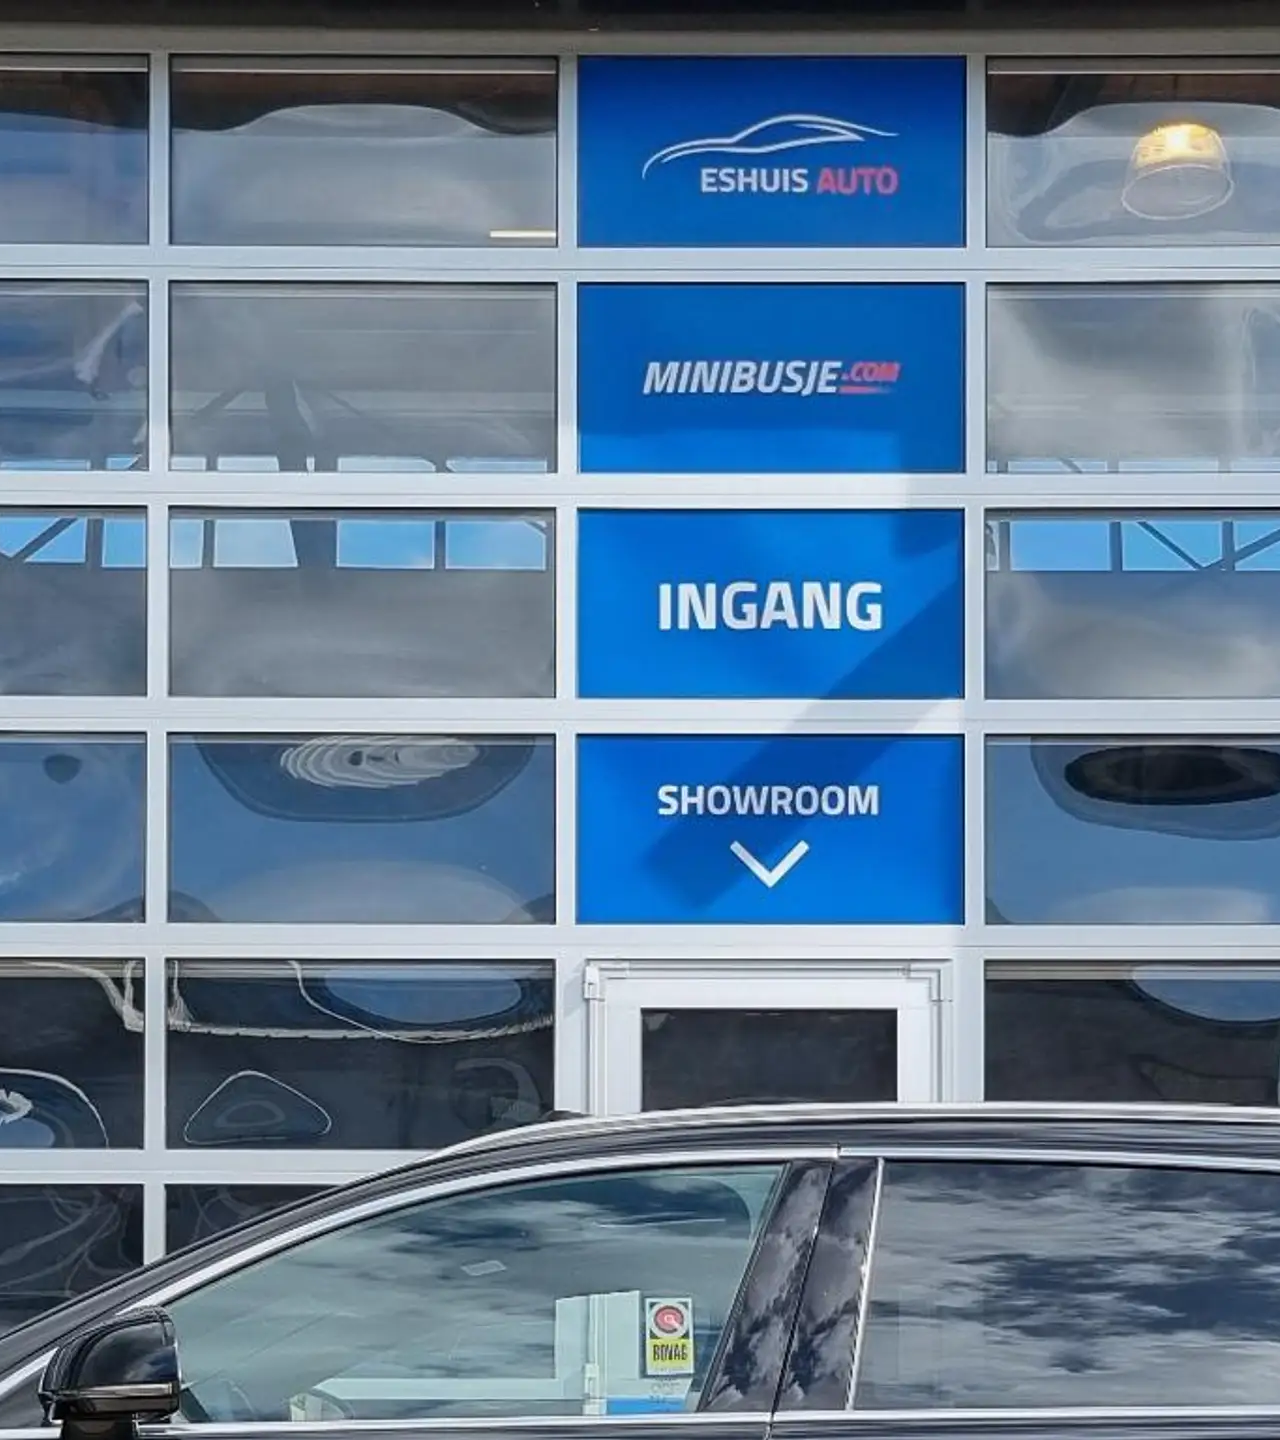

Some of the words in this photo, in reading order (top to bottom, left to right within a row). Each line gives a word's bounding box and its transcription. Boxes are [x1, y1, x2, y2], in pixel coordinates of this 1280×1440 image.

[699, 167, 809, 194] ESHUIS
[816, 166, 899, 195] AUTO
[657, 580, 882, 631] INGANG
[657, 784, 880, 817] SHOWROOM
